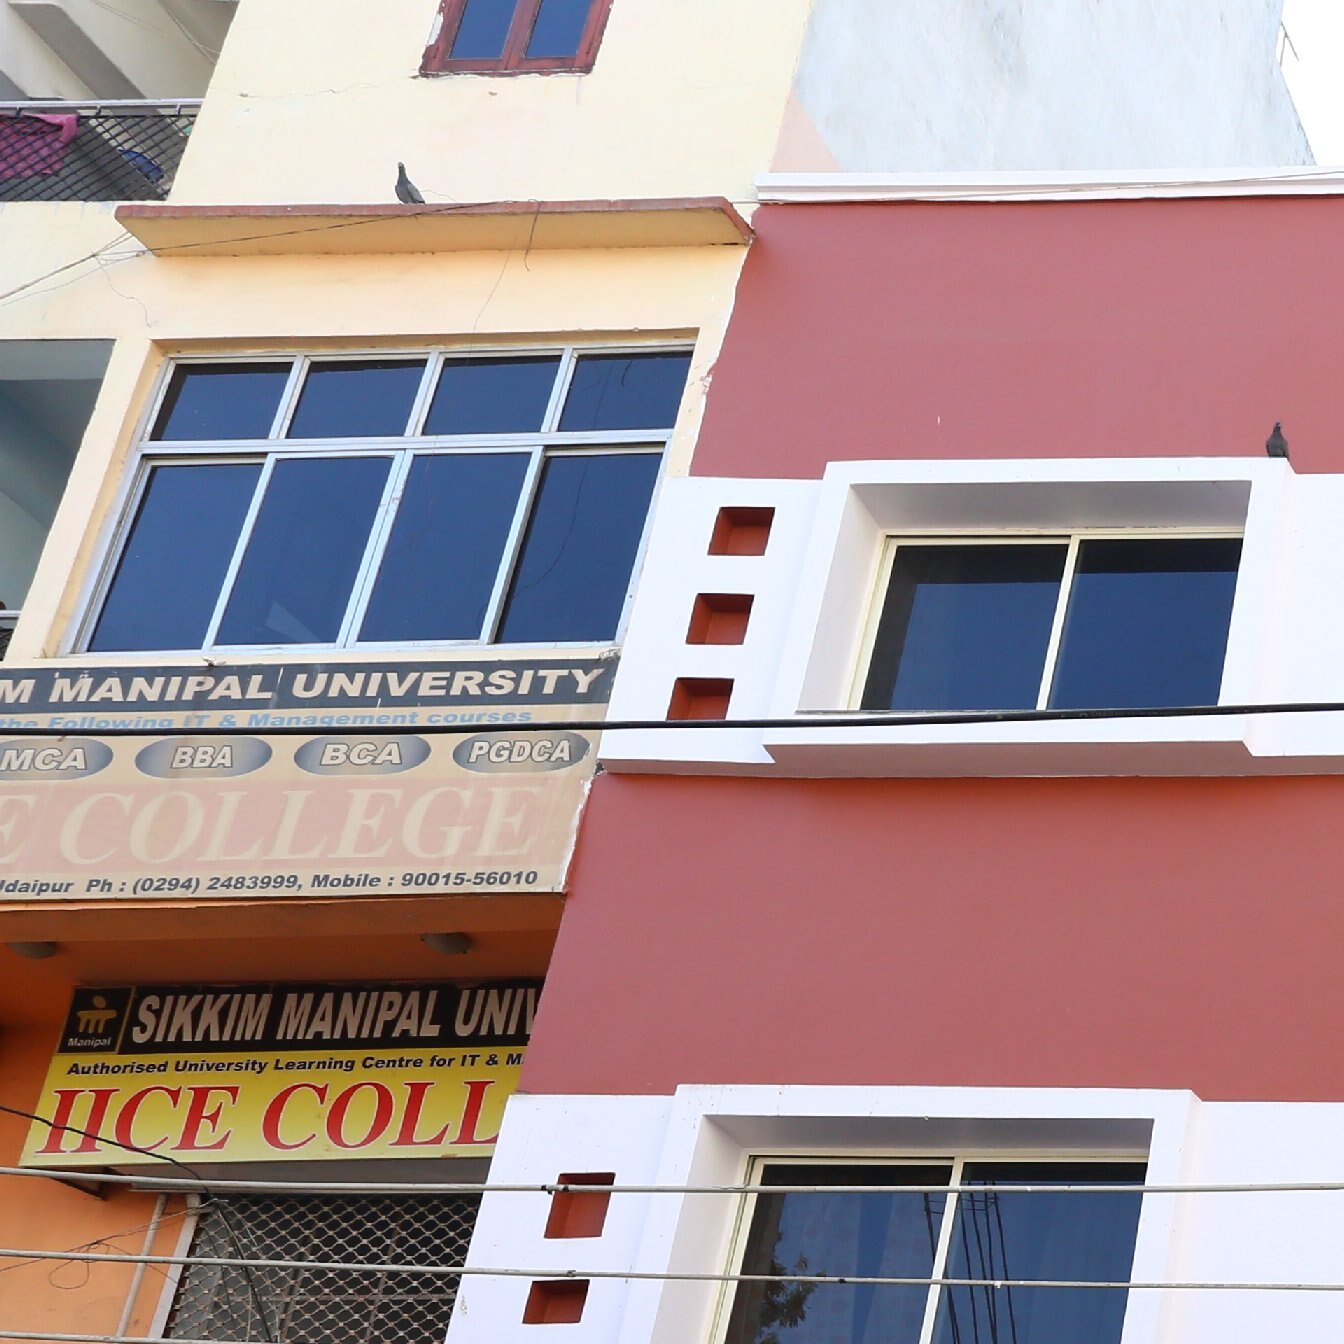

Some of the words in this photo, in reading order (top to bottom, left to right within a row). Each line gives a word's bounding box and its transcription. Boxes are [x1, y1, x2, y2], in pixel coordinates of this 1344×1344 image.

[49, 674, 273, 703] MANIPAL
[291, 668, 605, 698] UNIVERSITY
[48, 716, 174, 729] Following
[184, 715, 210, 728] IT
[248, 711, 419, 727] Management
[426, 711, 532, 724] courses
[0, 748, 87, 771] MCA
[170, 745, 233, 770] BBA
[319, 742, 403, 766] BCA
[468, 740, 572, 764] PGDCA
[59, 785, 546, 866] COLLEGE
[132, 876, 200, 895] (0294)
[310, 873, 381, 888] Mobile
[401, 870, 538, 886] 90015-56010
[132, 993, 273, 1043] SIKKIM
[275, 990, 442, 1040] MANIPAL
[67, 1037, 111, 1047] Manipal
[67, 1060, 168, 1075] Authorised
[174, 1059, 268, 1074] University
[273, 1057, 355, 1072] Learning
[362, 1056, 423, 1069] Centre
[429, 1055, 455, 1068] for
[460, 1054, 480, 1067] IT
[485, 1053, 499, 1066] &
[35, 1085, 240, 1155] IICE
